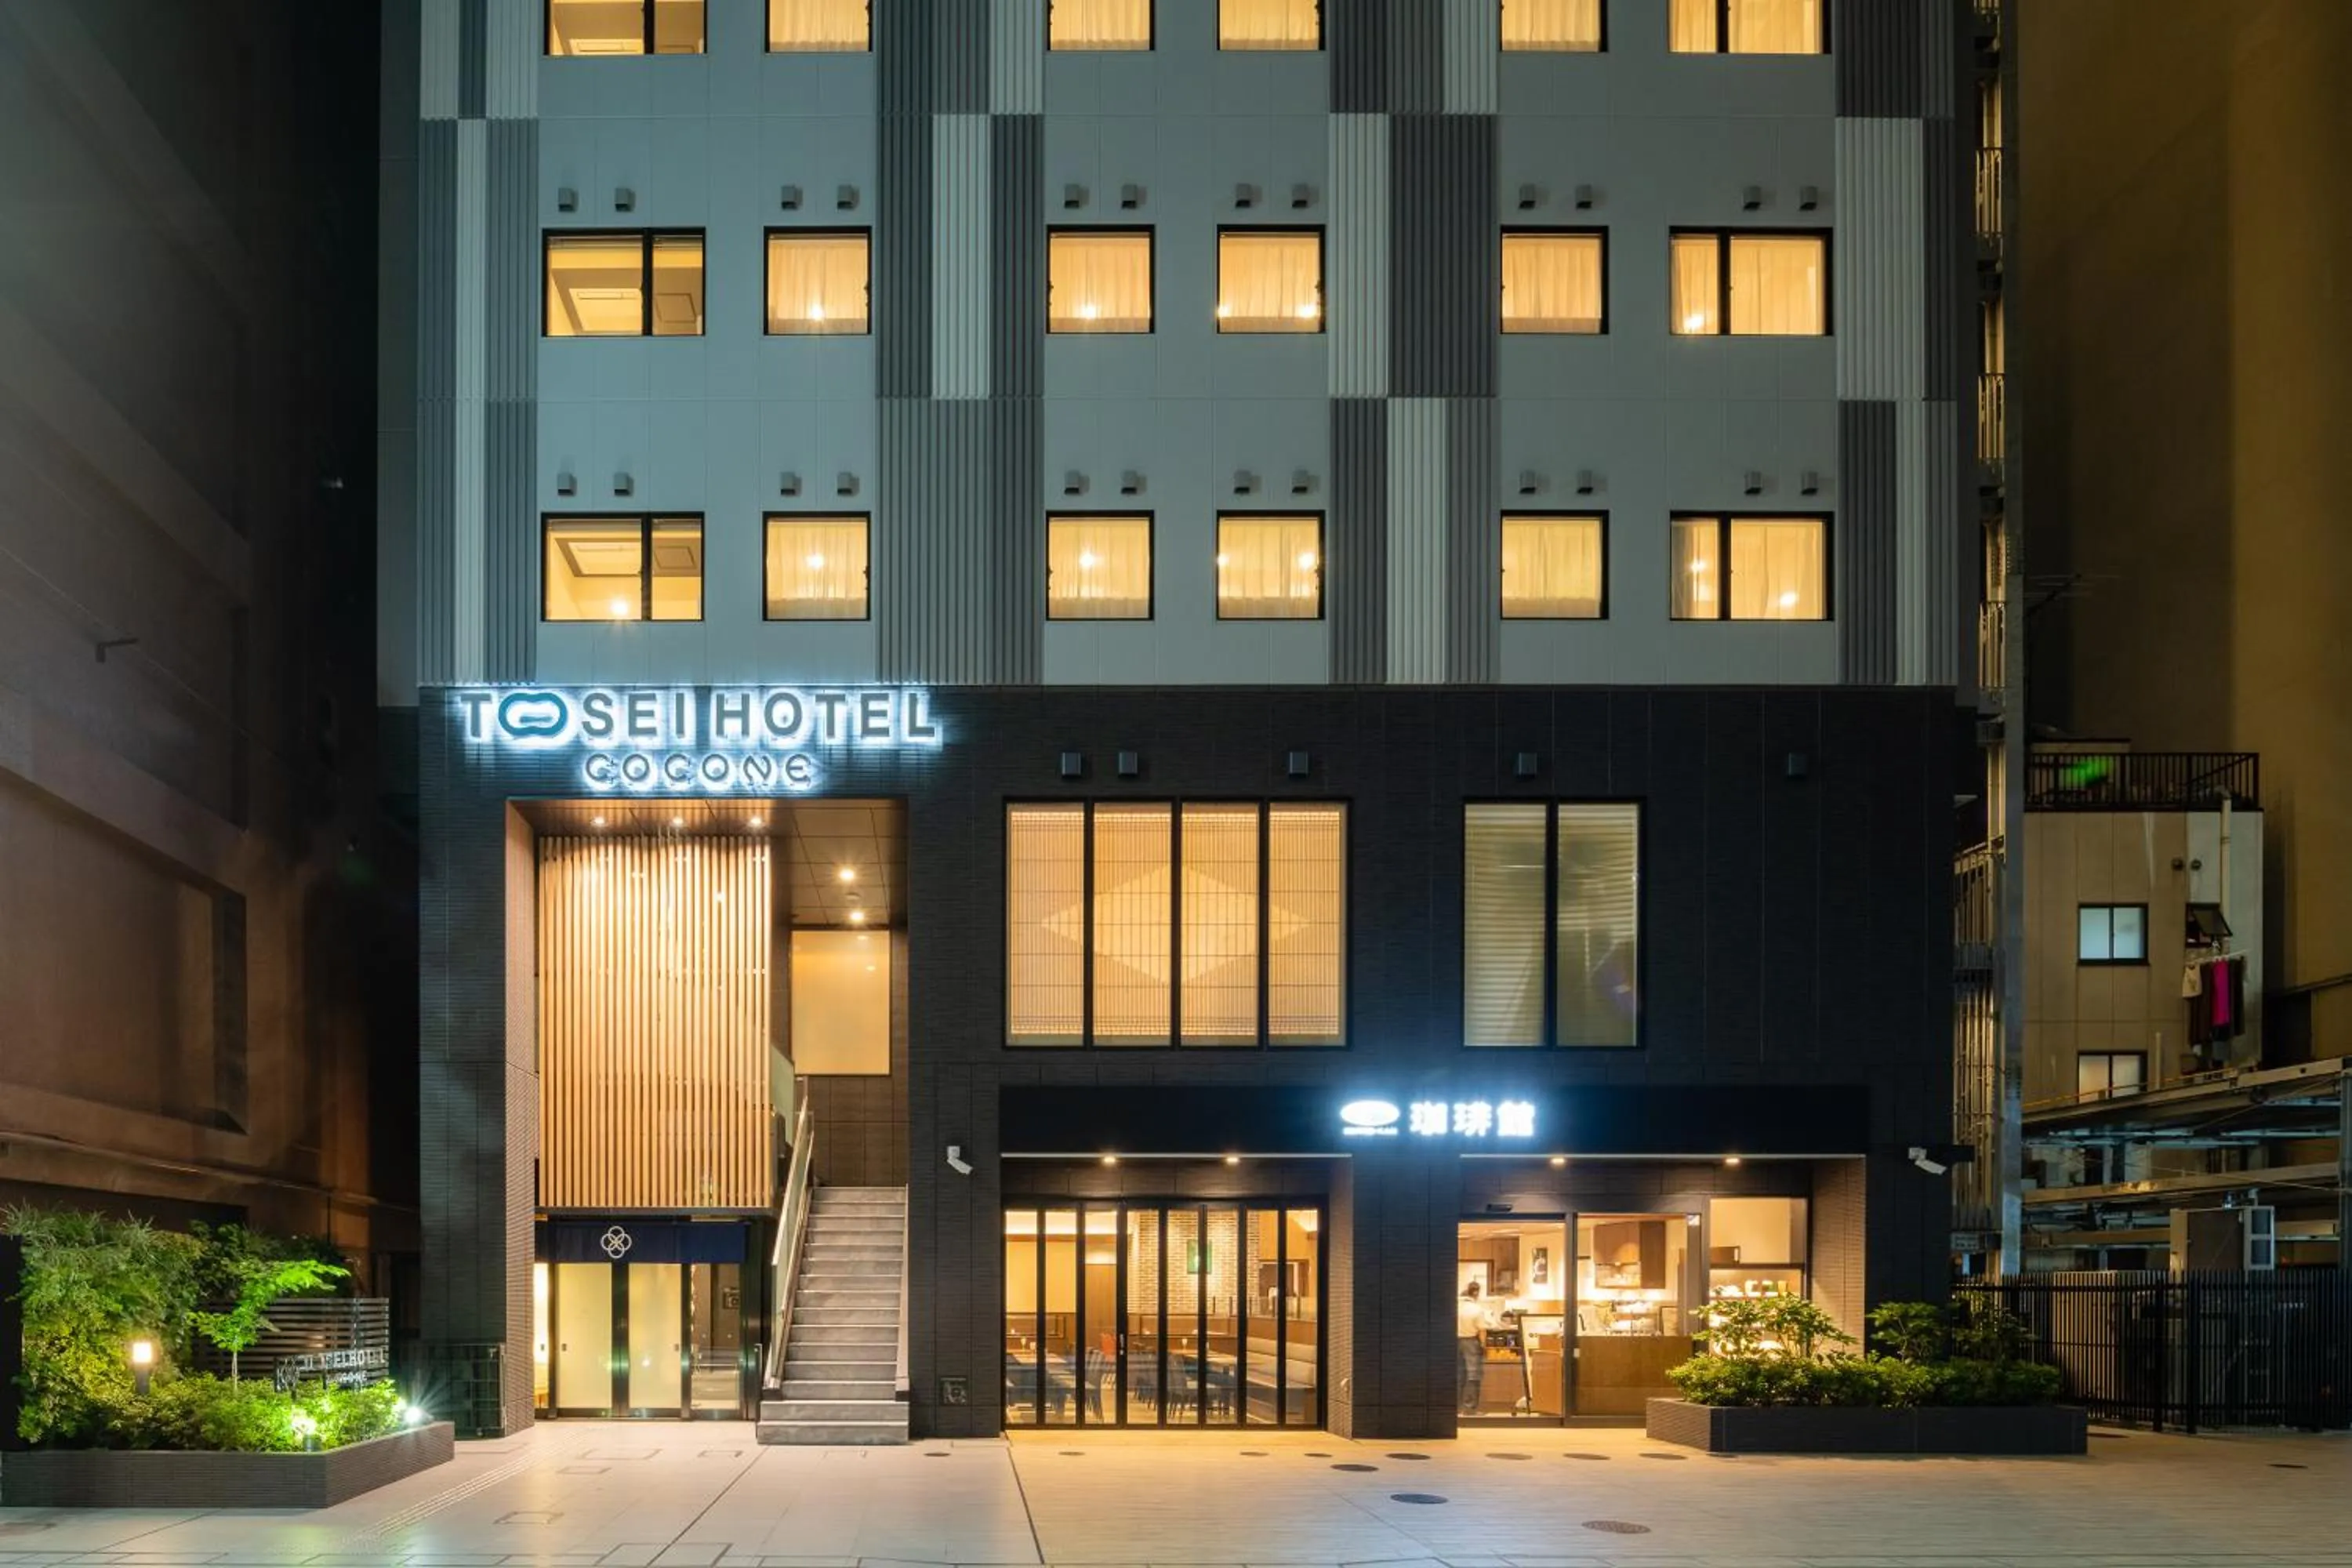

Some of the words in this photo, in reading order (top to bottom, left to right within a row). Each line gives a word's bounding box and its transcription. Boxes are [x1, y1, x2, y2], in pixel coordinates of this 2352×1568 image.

[459, 692, 687, 739] TOSEI
[715, 691, 935, 739] HOTEL
[586, 753, 811, 784] COCONE
[1410, 1100, 1534, 1137] 珈琲館
